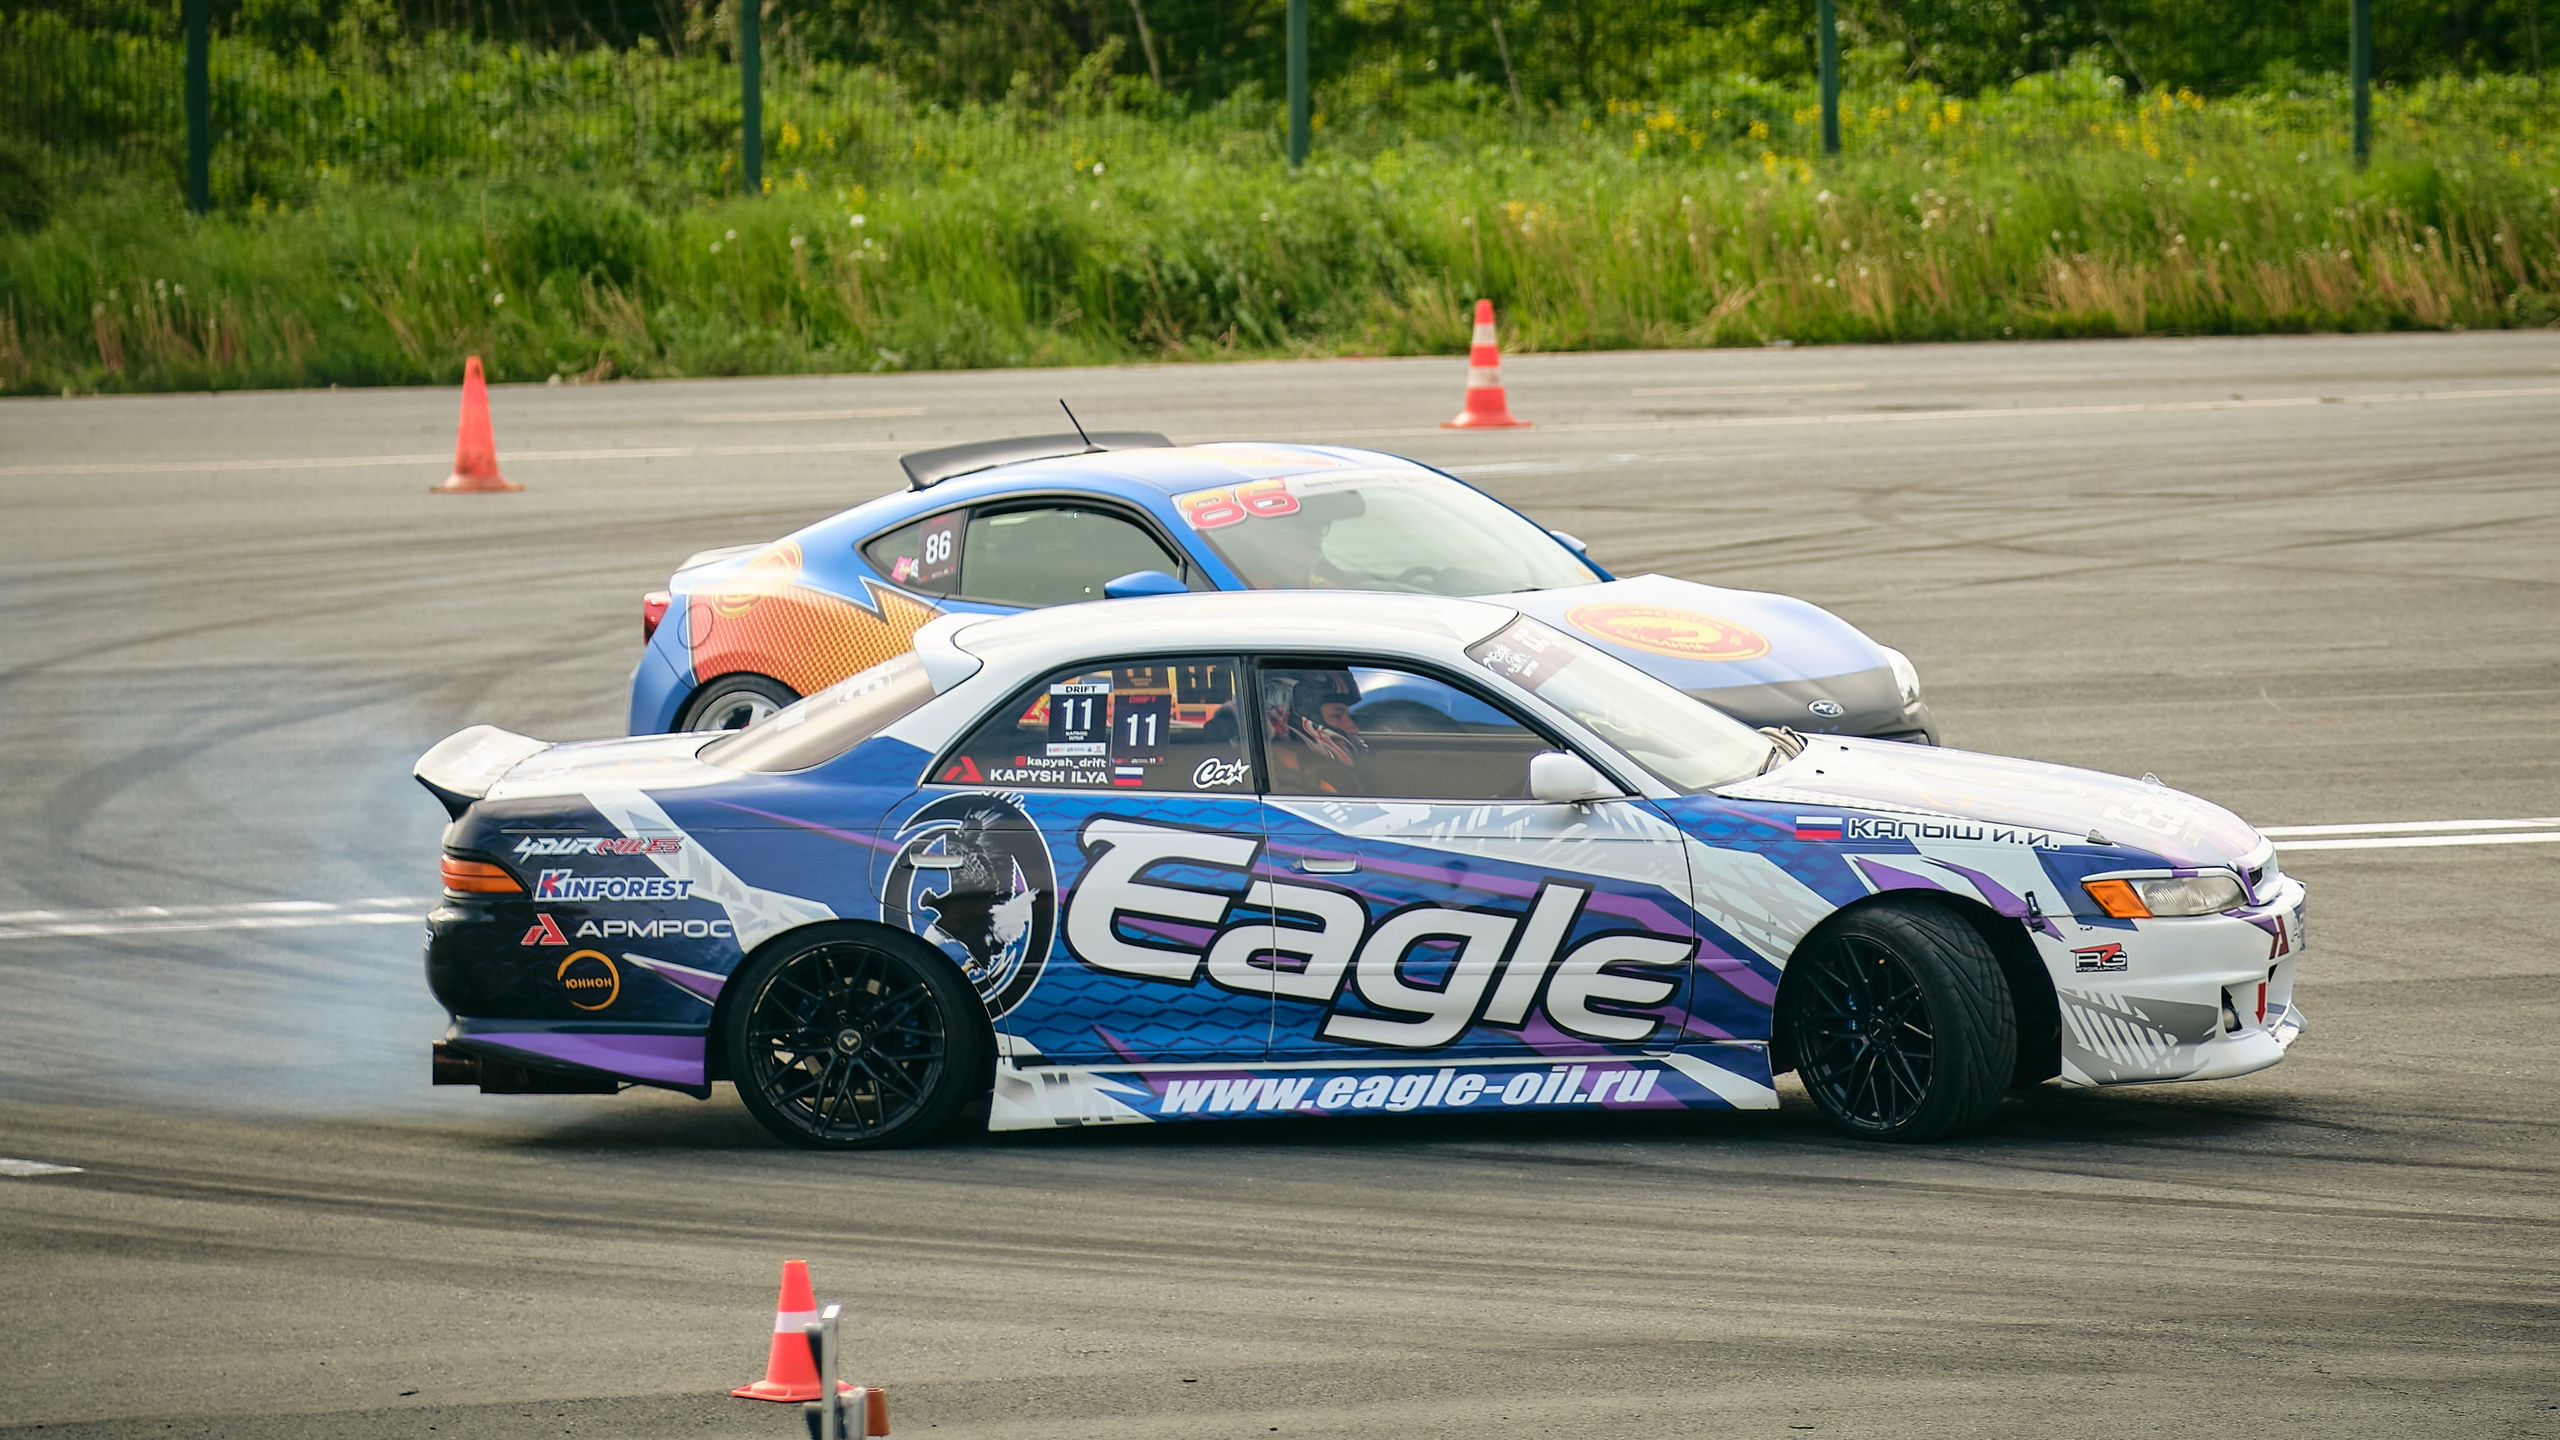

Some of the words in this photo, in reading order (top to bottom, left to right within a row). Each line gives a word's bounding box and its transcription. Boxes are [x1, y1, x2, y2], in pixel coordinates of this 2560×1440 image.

[1180, 478, 1300, 530] 86
[925, 529, 952, 565] 86
[1065, 685, 1098, 693] DRIFT
[1062, 698, 1093, 731] 11
[1126, 713, 1157, 747] 11
[989, 768, 1065, 783] KAPYSH
[1070, 771, 1109, 784] ILYA
[1026, 756, 1107, 769] kapysh_drift
[1850, 818, 1985, 841] КАПЫШ
[1993, 827, 2061, 849] И.И.
[534, 868, 694, 902] KINFOREST
[1063, 815, 1701, 1048] Eagle
[1159, 1065, 1661, 1114] www.eagle-oil.ru
